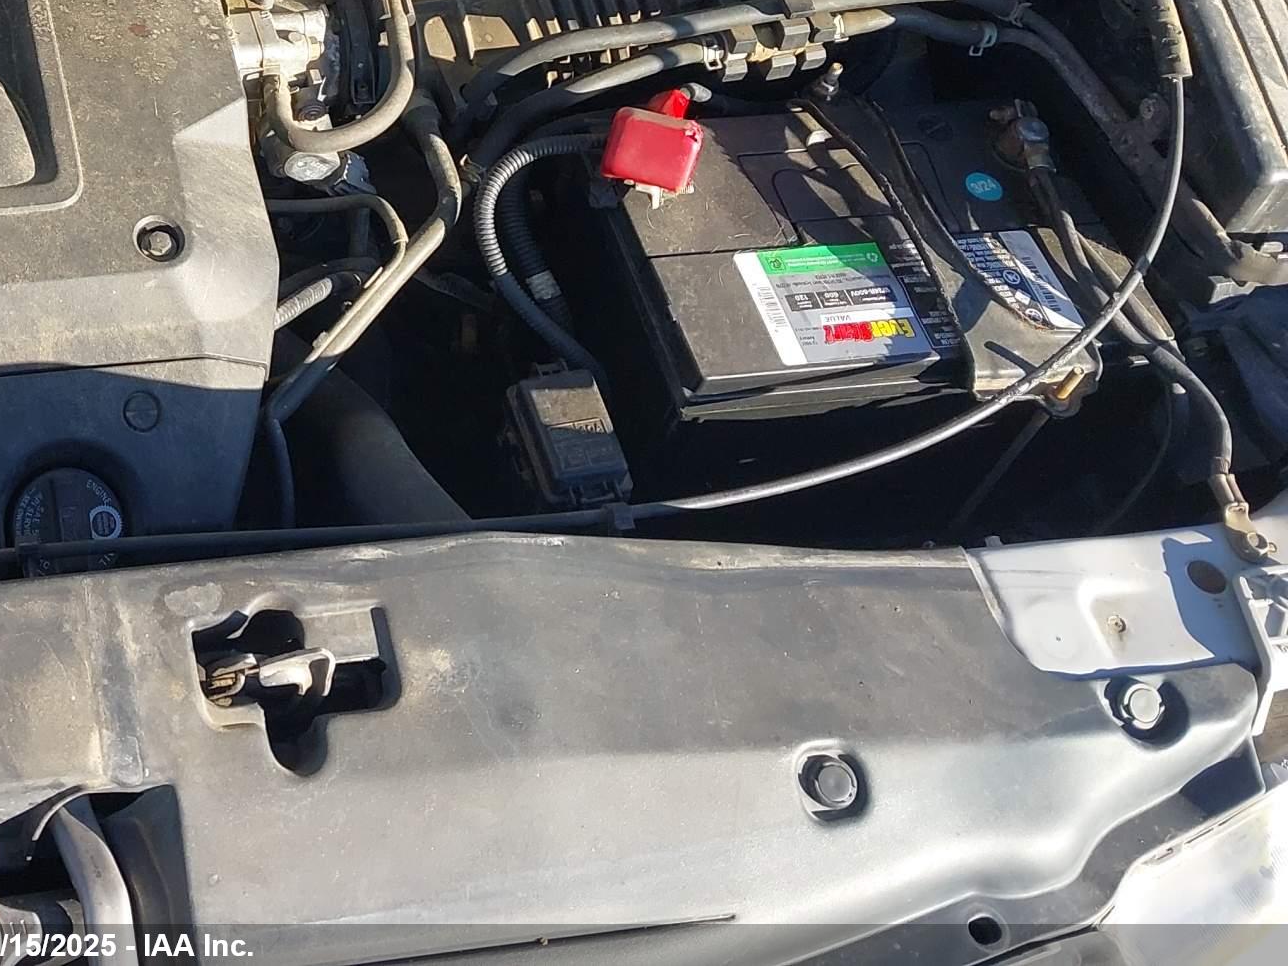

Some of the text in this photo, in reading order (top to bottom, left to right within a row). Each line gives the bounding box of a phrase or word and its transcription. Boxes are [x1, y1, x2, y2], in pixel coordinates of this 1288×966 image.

[822, 316, 916, 345] EverStart
[825, 314, 851, 323] VALUE
[86, 479, 112, 506] ENGINE
